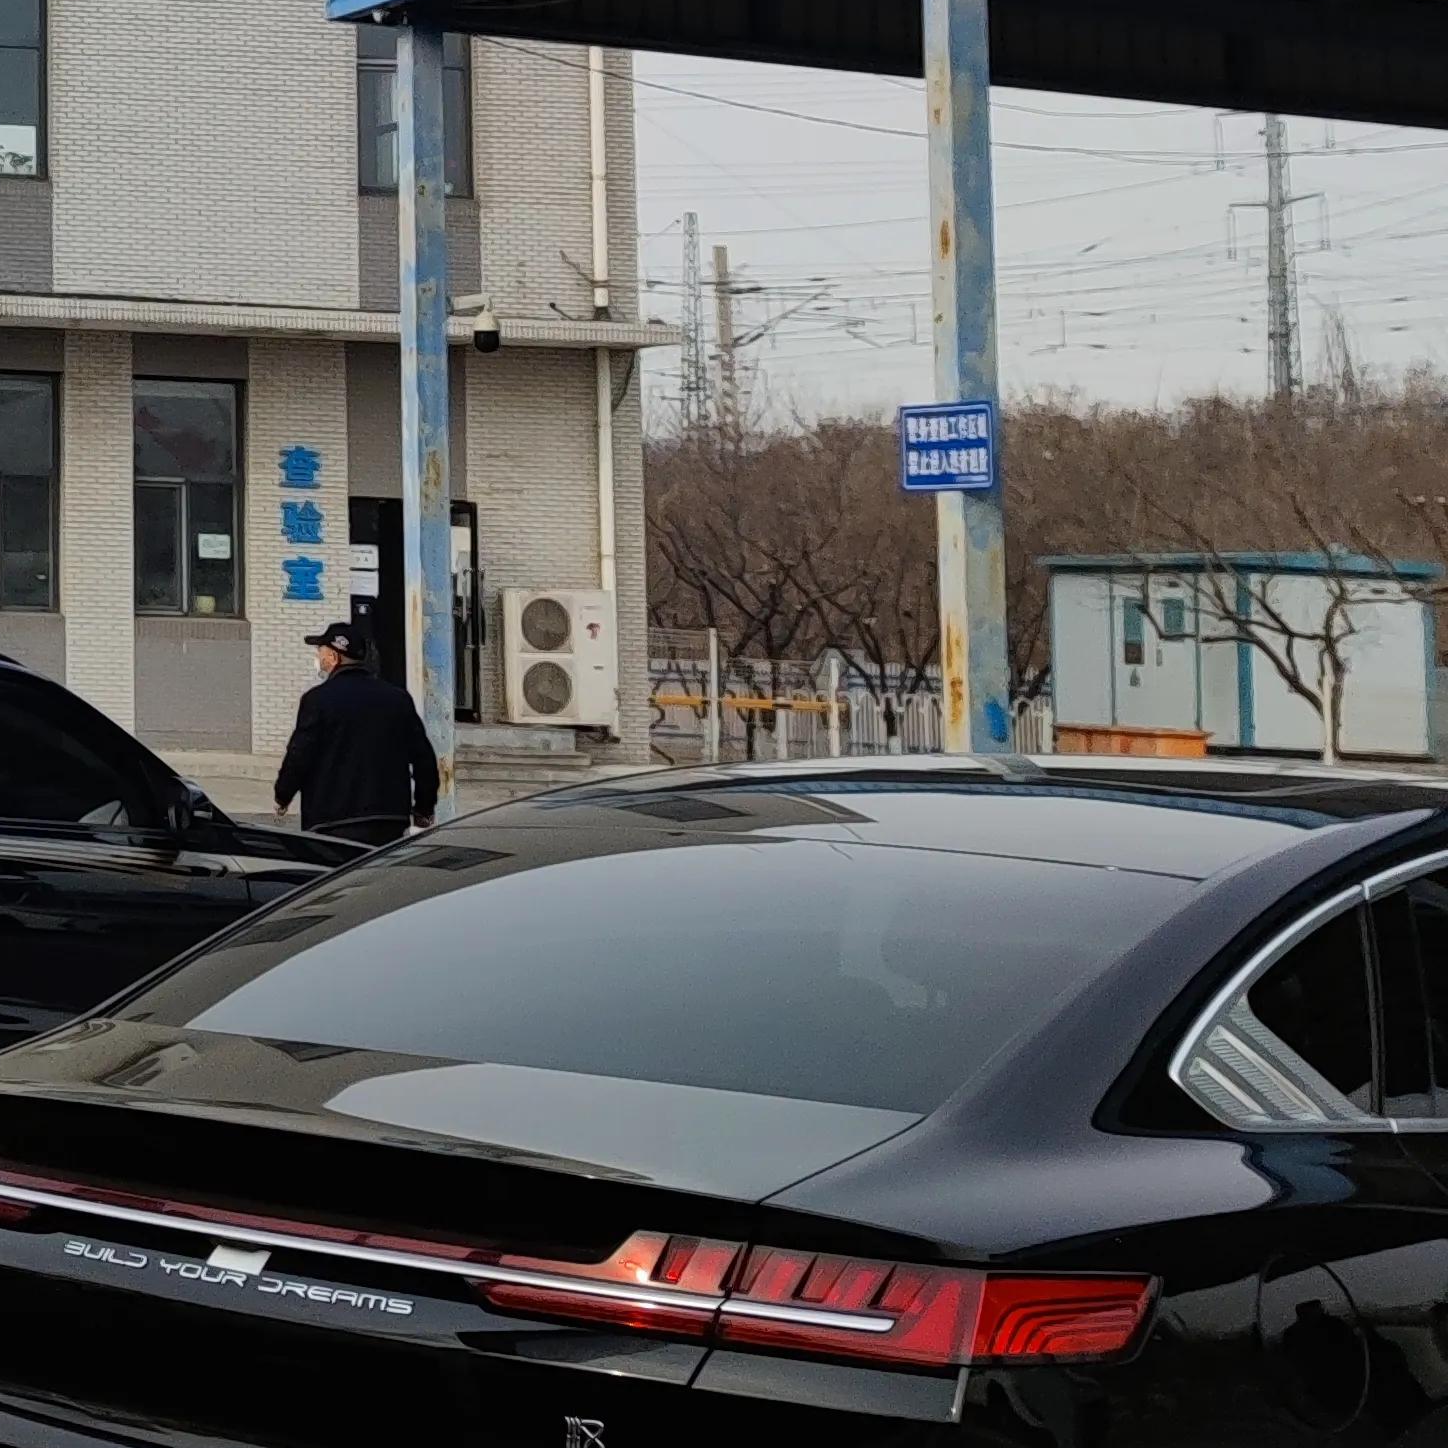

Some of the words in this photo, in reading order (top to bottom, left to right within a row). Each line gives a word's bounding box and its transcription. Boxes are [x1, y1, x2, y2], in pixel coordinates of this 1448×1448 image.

[278, 445, 324, 601] 查验室
[63, 1239, 148, 1269] BUILD
[159, 1258, 248, 1288] YOUR
[257, 1276, 415, 1316] DREAMS
